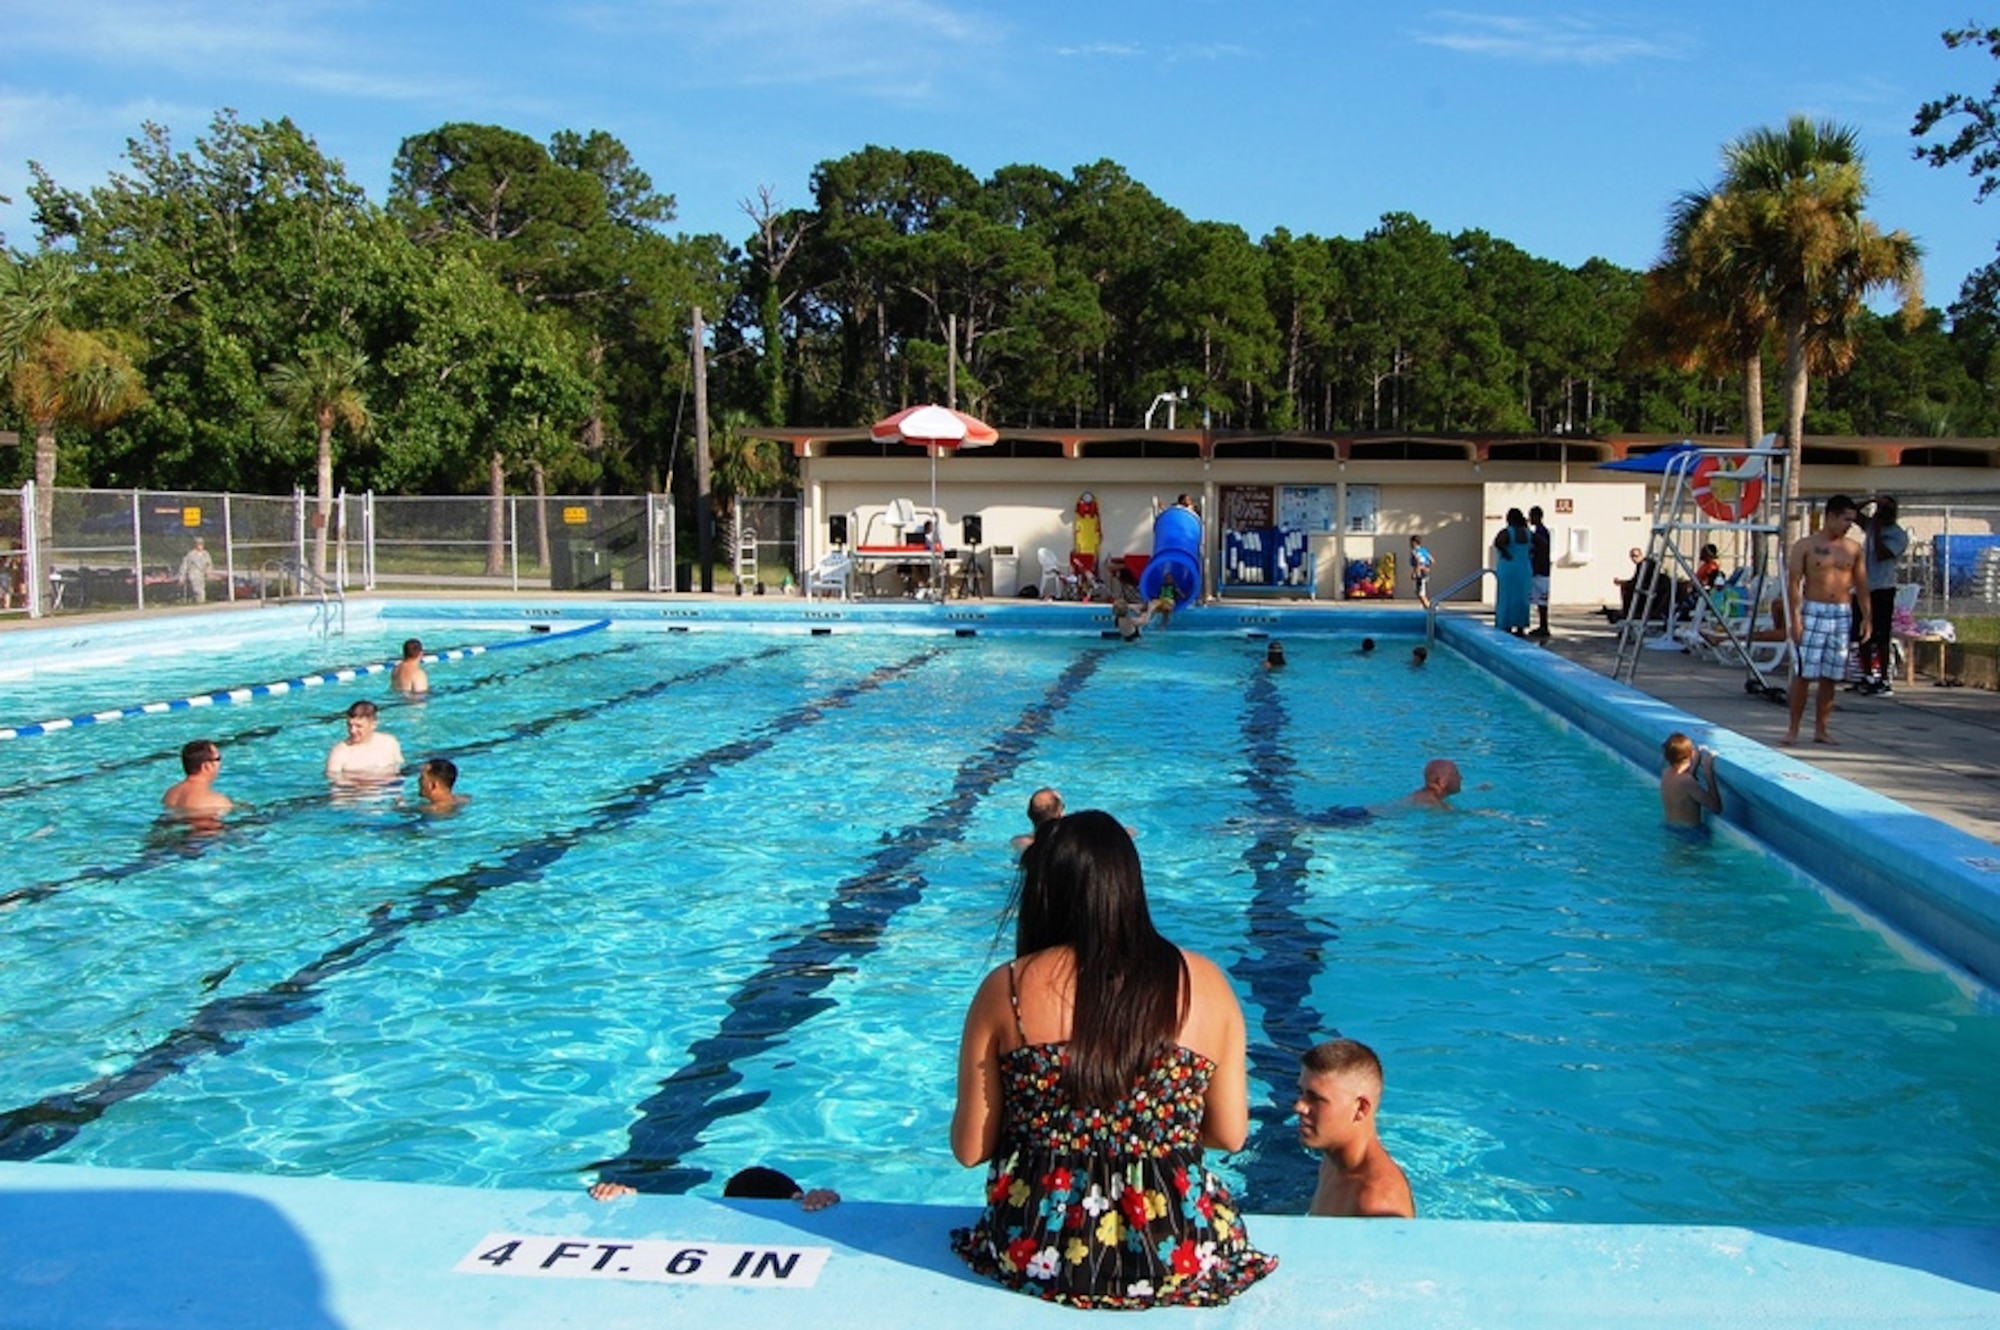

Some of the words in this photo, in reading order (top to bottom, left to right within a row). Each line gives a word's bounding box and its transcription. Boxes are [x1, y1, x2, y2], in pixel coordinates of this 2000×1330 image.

[478, 1240, 522, 1266] 4
[539, 1242, 632, 1272] FT.
[665, 1248, 708, 1275] 6
[728, 1251, 802, 1279] IN
